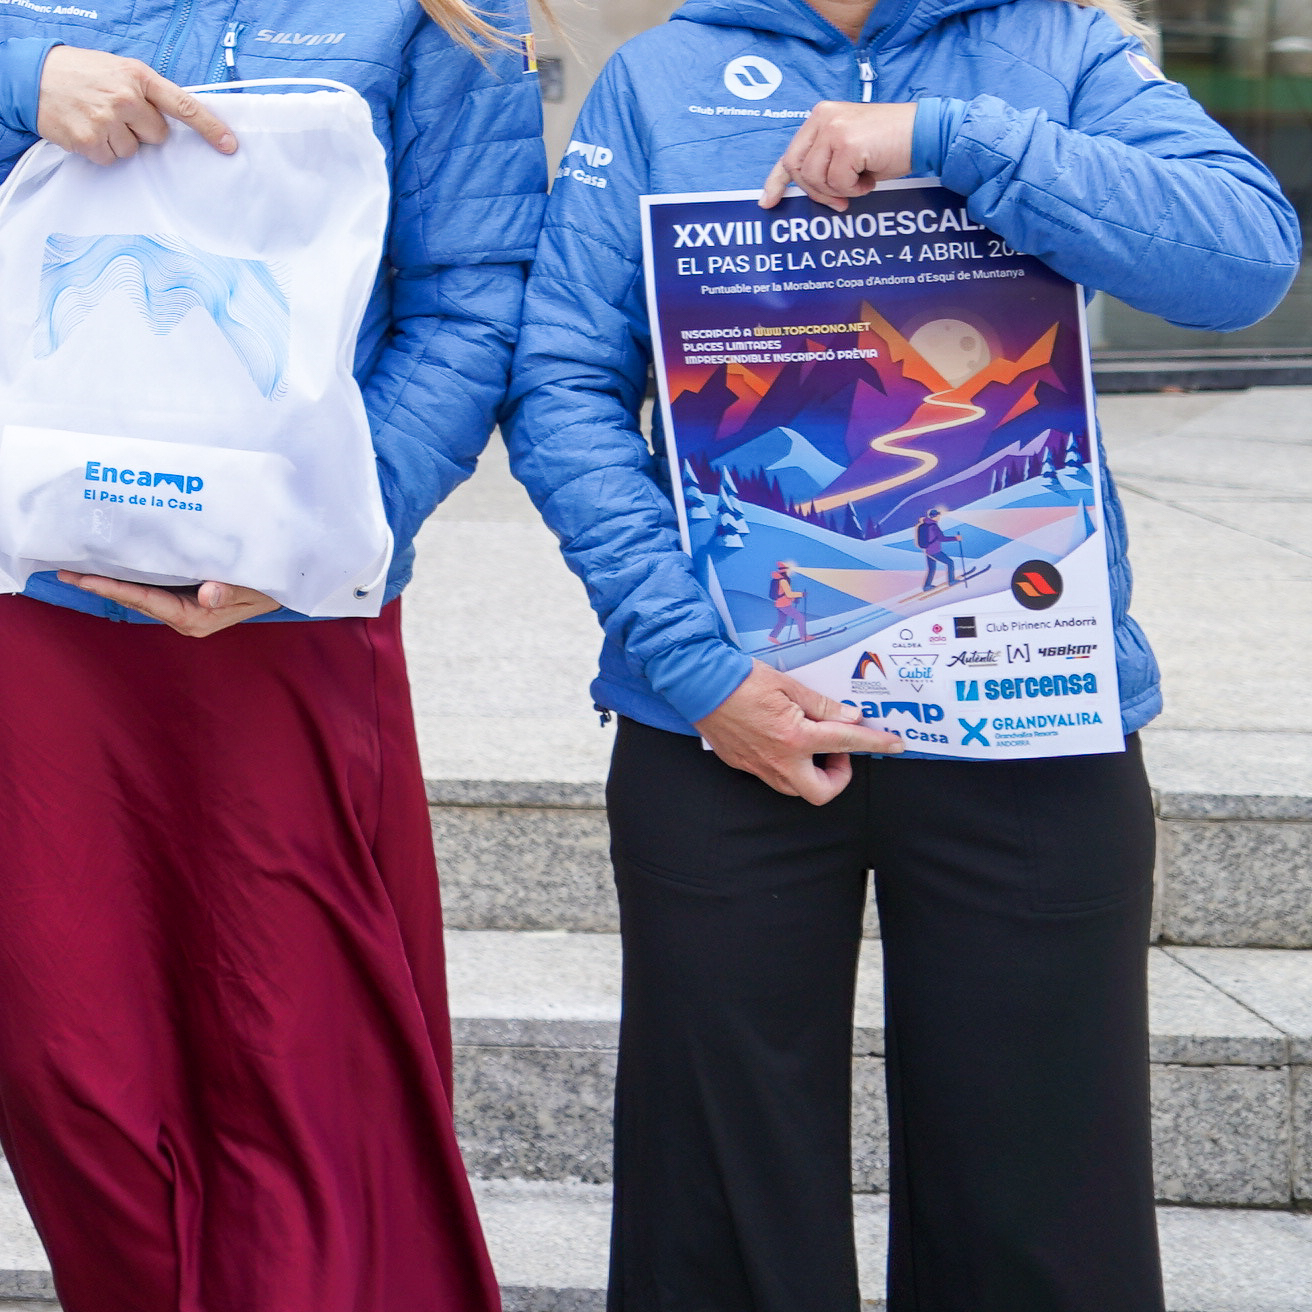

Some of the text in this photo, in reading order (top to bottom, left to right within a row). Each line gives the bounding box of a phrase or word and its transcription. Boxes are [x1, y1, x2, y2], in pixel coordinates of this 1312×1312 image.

[53, 5, 98, 19] Andorrà
[688, 105, 714, 116] Club
[716, 106, 760, 117] Pirinenc
[572, 169, 607, 189] Casa
[672, 207, 985, 248] XXVIII CRONOESCAL
[678, 241, 984, 276] EL PAS DE LA CASA 4 ABRIL
[701, 284, 752, 295] Puntuable
[753, 286, 770, 294] per
[772, 282, 782, 291] la
[784, 279, 835, 291] Morabanc
[836, 277, 864, 289] Copa
[866, 274, 915, 286] d'Andorra
[957, 270, 971, 280] de
[973, 268, 1025, 280] Muntanya
[681, 326, 742, 340] INSCRIPCIÓ
[683, 340, 782, 352] PLACES LIMITADES
[684, 353, 772, 365] IMPRESCINDIBLE
[85, 460, 204, 495] Encamp
[84, 489, 203, 512] El Pas de la Casa
[986, 621, 1009, 632] Club
[984, 672, 1098, 701] sercensa
[992, 712, 1103, 731] GRANDVALIRA
[905, 728, 949, 744] Casa
